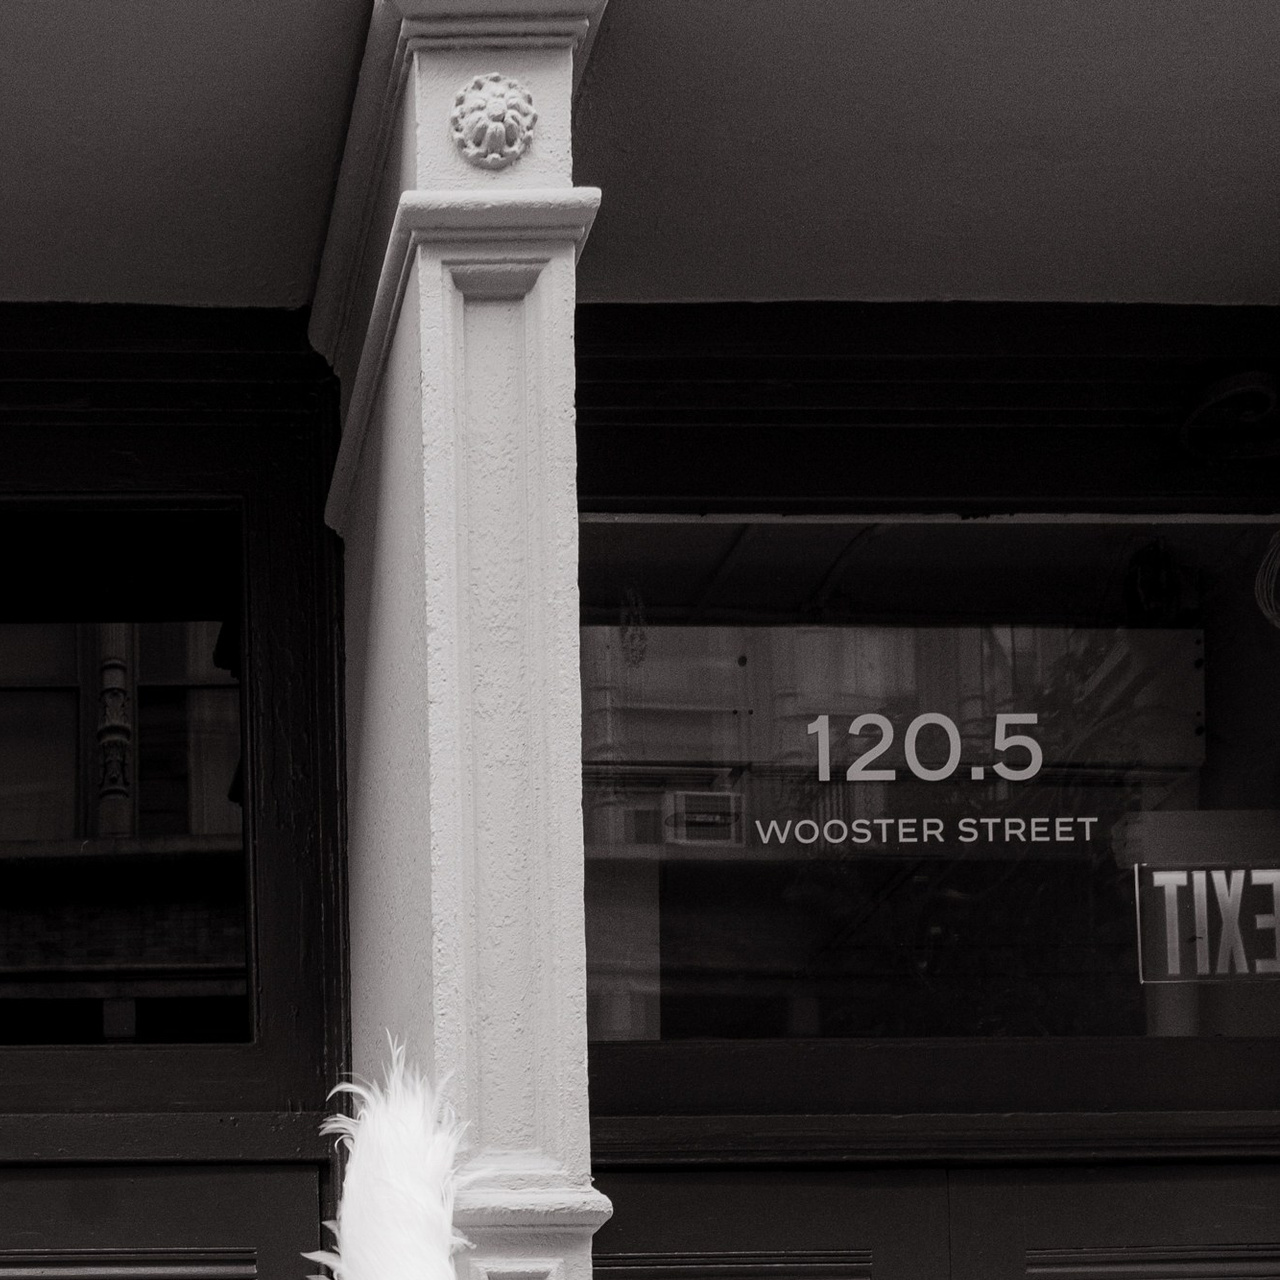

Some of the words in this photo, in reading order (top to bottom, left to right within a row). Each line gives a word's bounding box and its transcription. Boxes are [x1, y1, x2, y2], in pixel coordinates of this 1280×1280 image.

[807, 712, 1043, 782] 120.5
[754, 818, 945, 844] WOOSTER
[957, 816, 1098, 843] STREET
